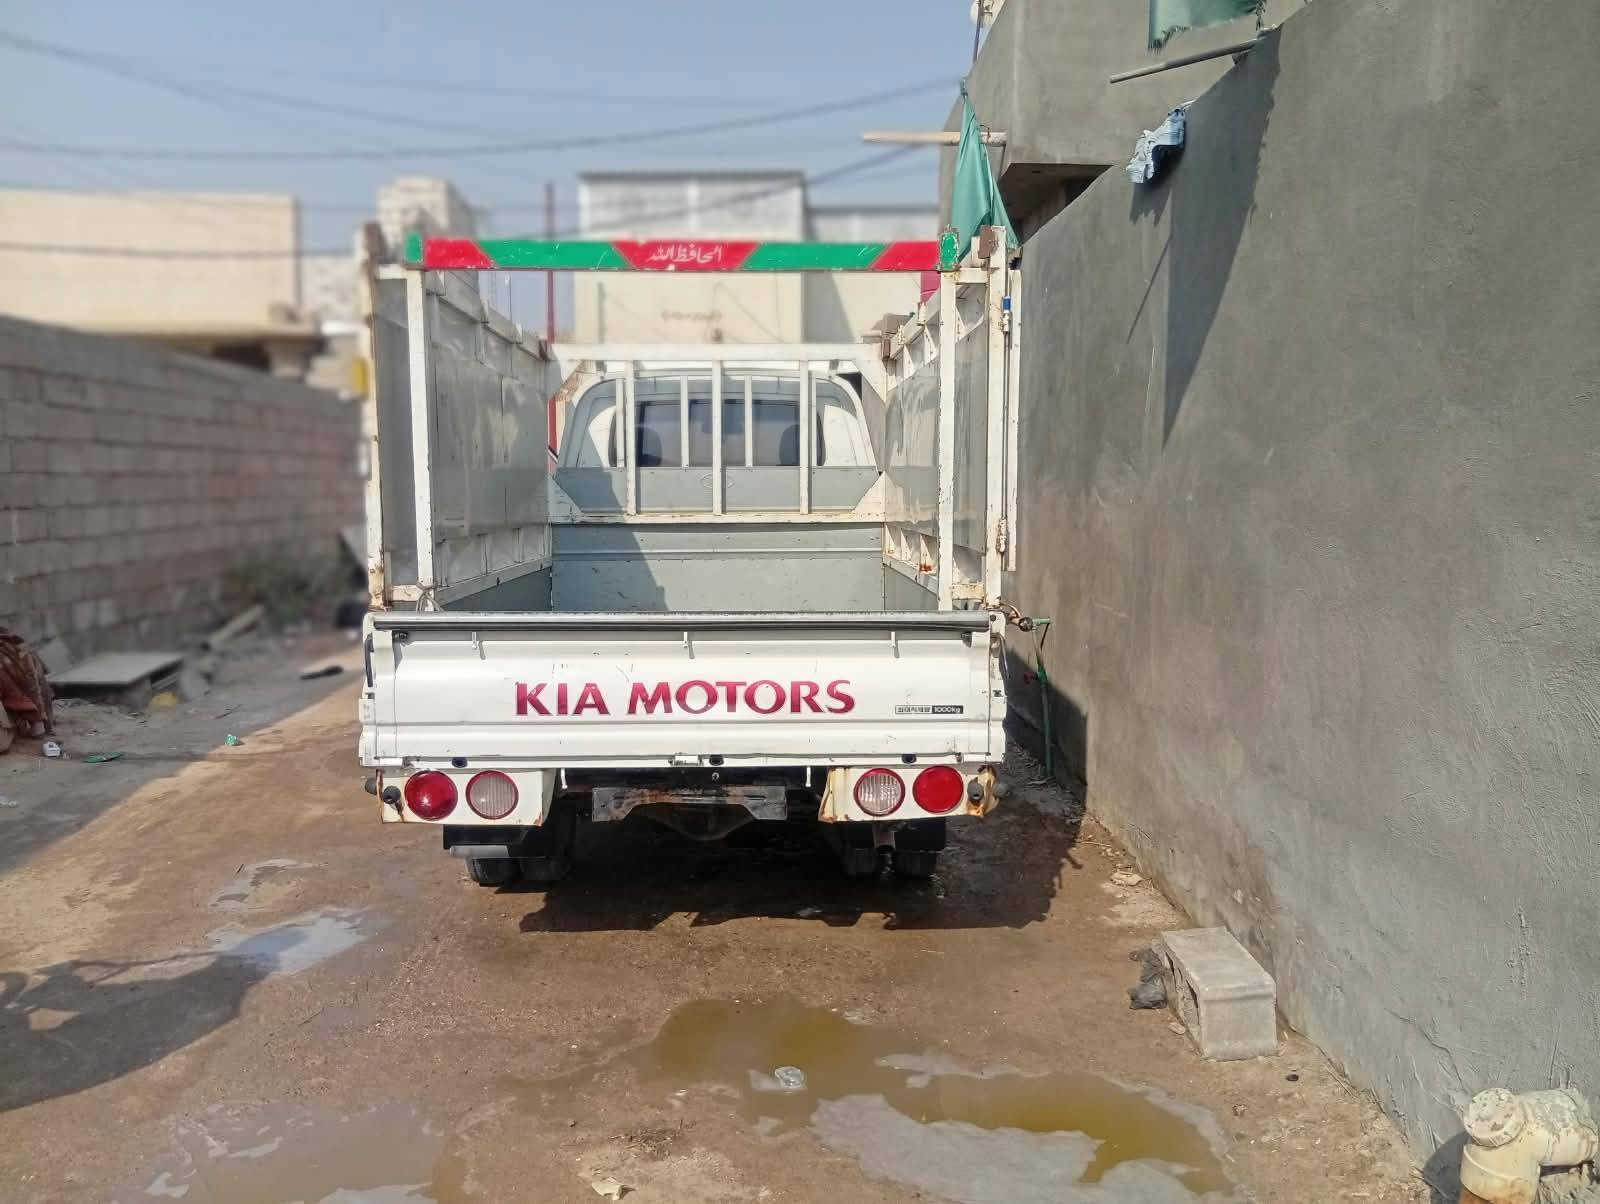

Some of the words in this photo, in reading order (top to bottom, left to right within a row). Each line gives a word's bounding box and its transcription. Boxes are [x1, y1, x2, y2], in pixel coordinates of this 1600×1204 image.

[515, 682, 611, 716] KIA
[627, 680, 855, 715] MOTORS
[934, 706, 961, 714] 1000kg
